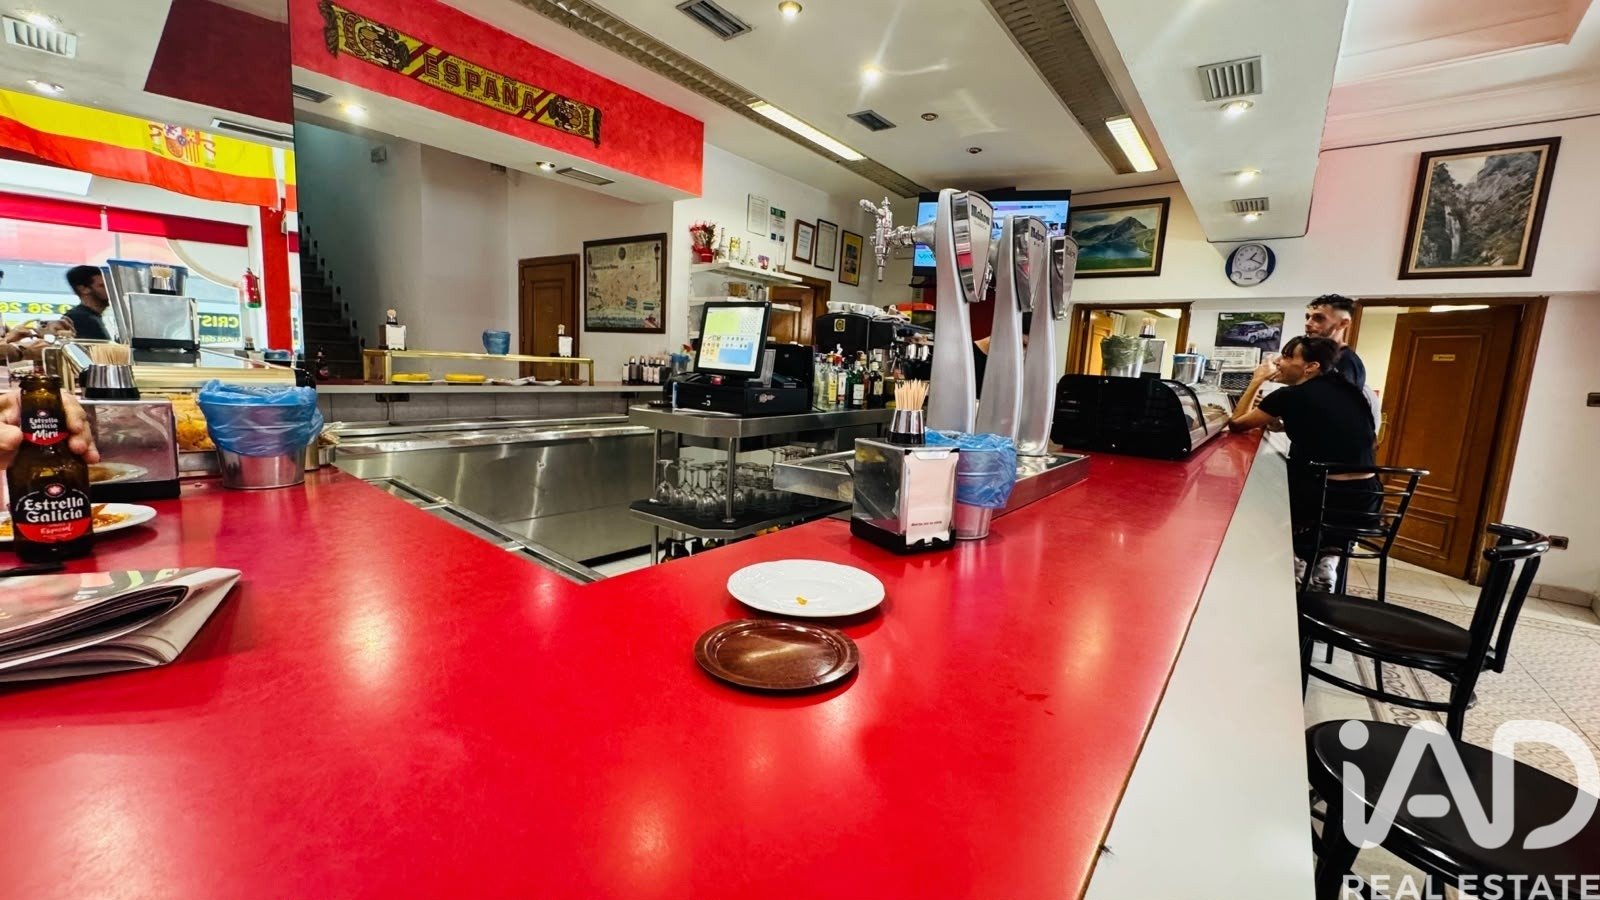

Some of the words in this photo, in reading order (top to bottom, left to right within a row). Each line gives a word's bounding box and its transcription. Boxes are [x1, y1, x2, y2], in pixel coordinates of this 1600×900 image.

[423, 52, 537, 113] ESPAÑA
[32, 429, 59, 441] Mini
[24, 497, 84, 511] Estrella
[26, 508, 83, 523] Galicia
